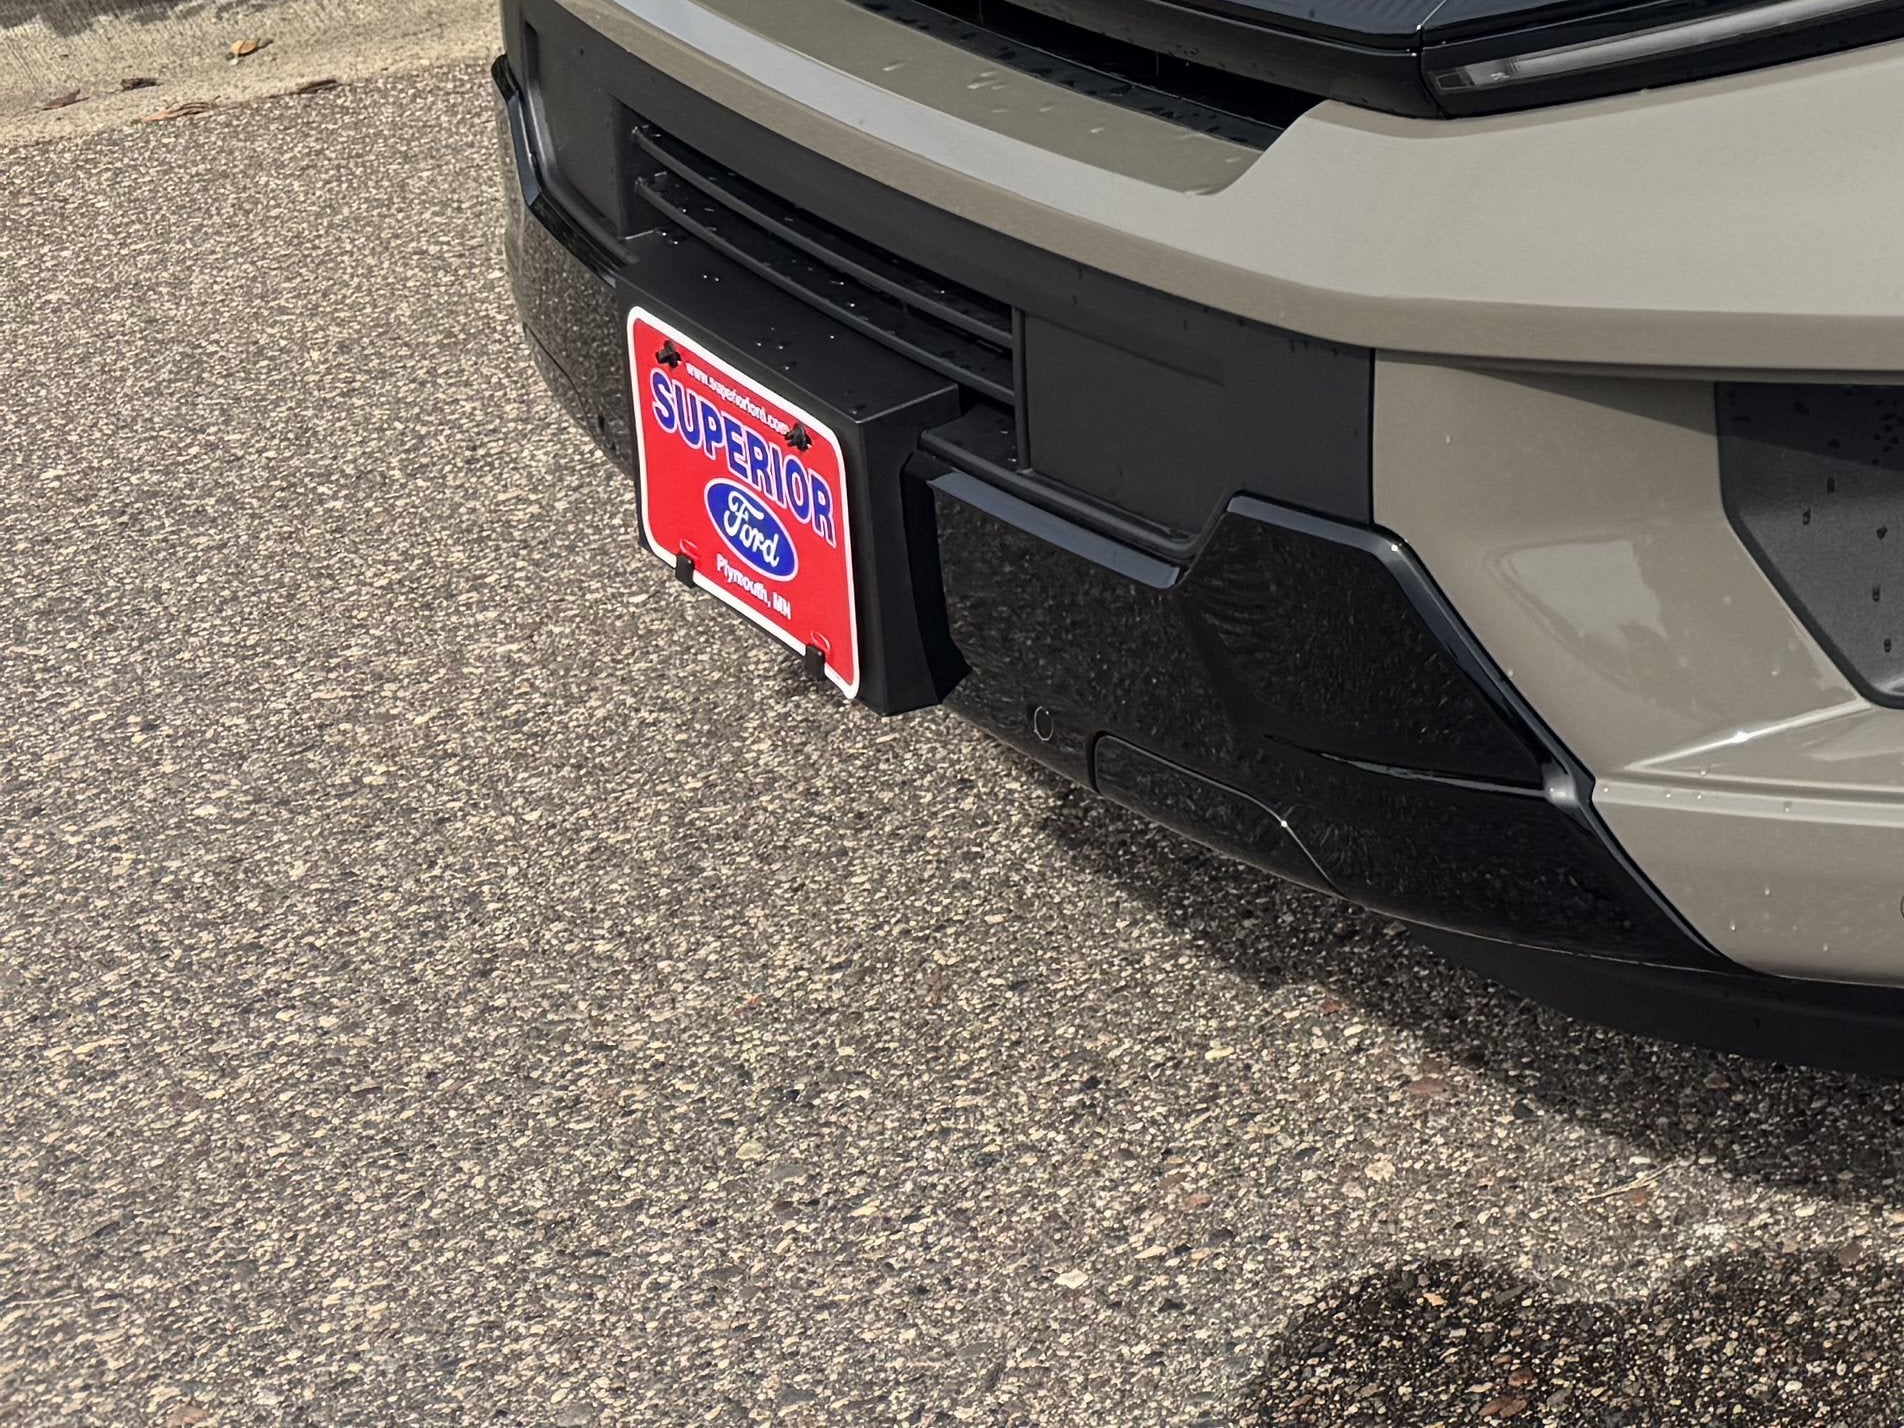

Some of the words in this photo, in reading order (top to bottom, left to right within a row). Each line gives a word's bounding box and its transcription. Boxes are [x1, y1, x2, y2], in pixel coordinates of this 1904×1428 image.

[650, 368, 837, 558] SUPERIOR
[723, 490, 780, 568] Ford
[716, 553, 771, 608] Plymouth,
[772, 591, 792, 621] MN
